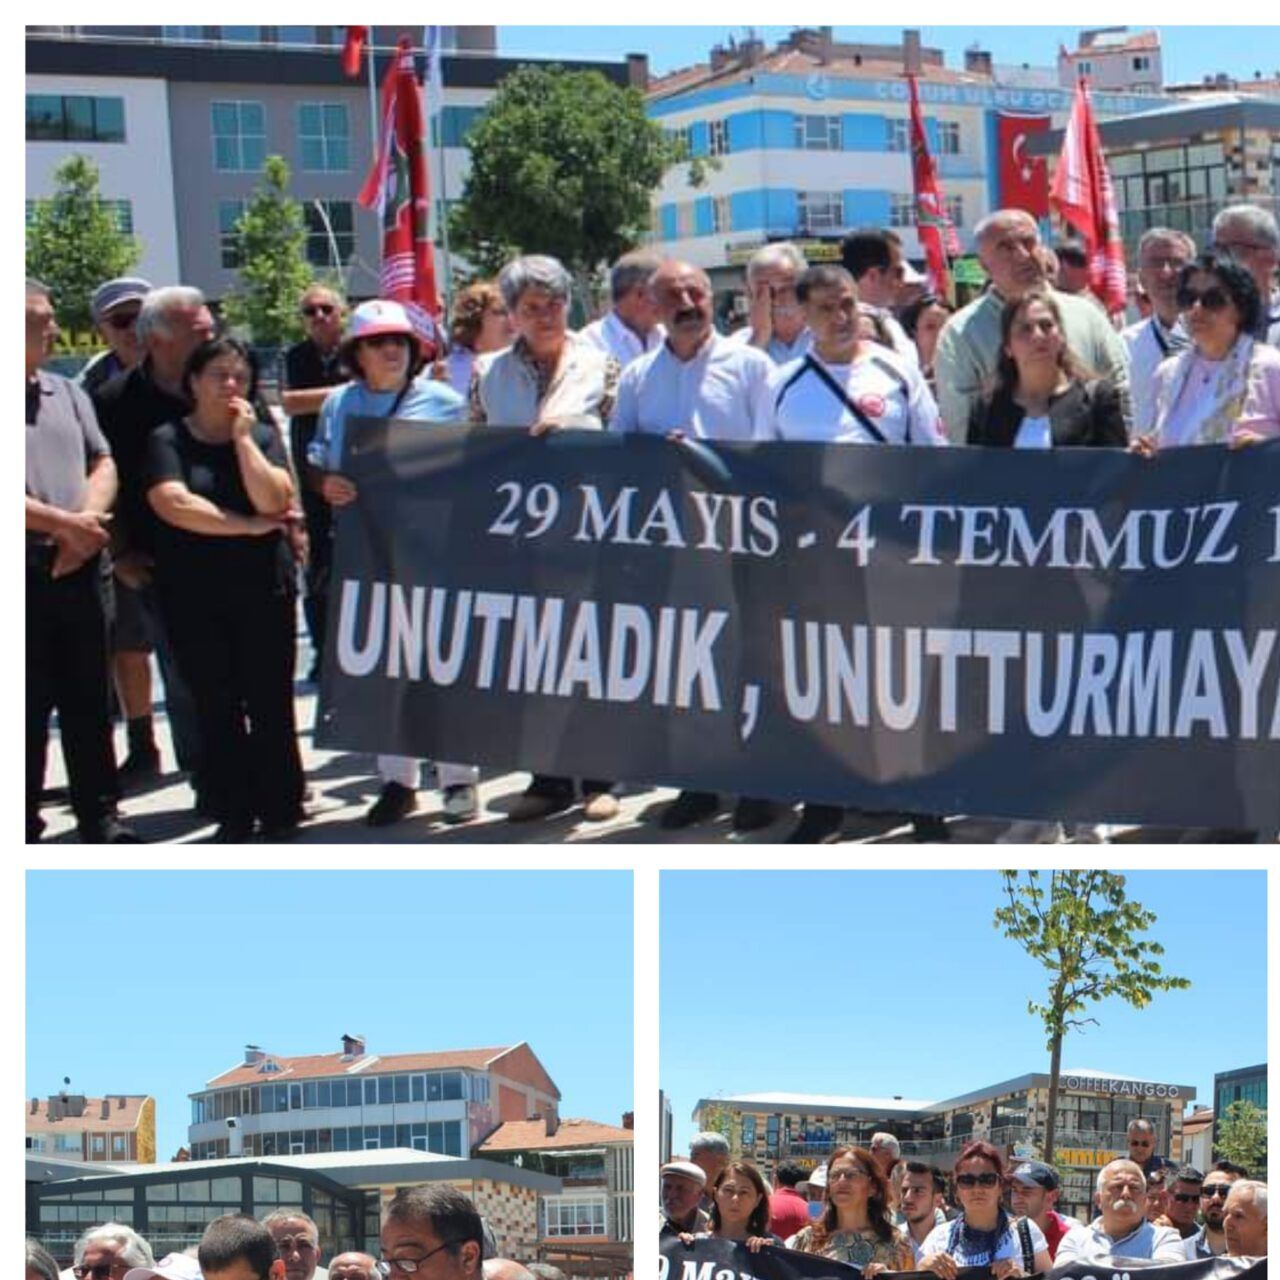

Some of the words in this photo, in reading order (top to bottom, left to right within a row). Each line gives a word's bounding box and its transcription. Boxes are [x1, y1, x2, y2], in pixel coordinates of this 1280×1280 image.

[489, 481, 560, 539] 29
[574, 484, 780, 557] MAYIS
[837, 504, 877, 567] 4
[900, 499, 1240, 571] TEMMUZ
[336, 578, 730, 711] UNUTMADIK
